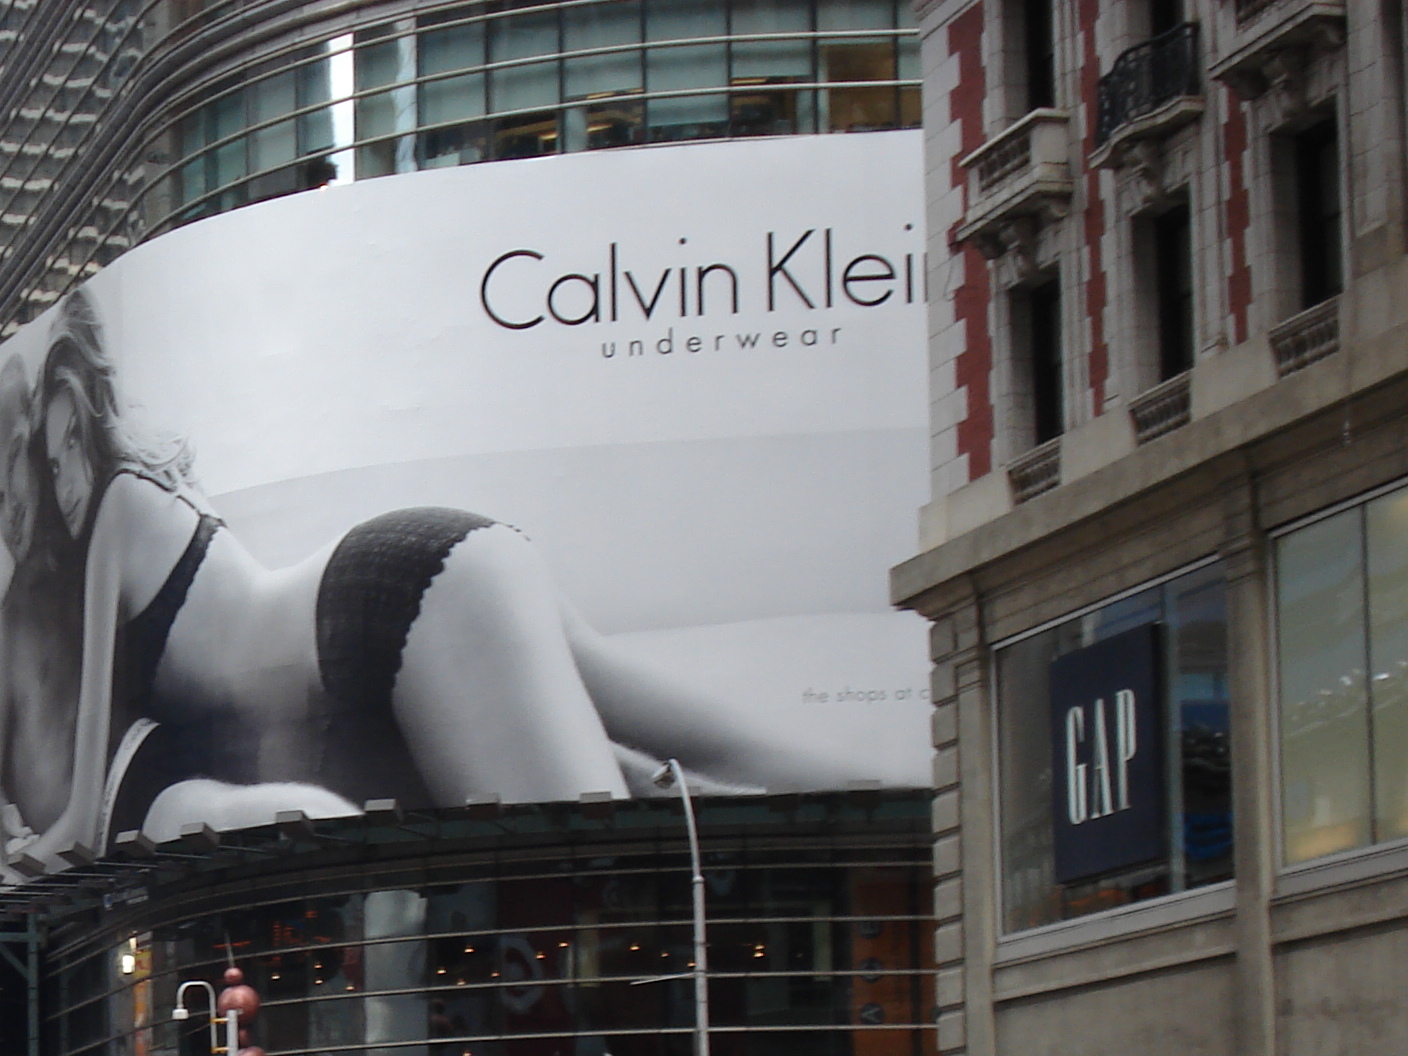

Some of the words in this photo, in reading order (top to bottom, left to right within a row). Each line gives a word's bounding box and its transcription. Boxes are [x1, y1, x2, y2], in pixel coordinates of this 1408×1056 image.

[481, 237, 739, 331] Calvin
[765, 222, 928, 312] Klei
[601, 327, 842, 359] underwear
[1065, 688, 1137, 825] GAP
